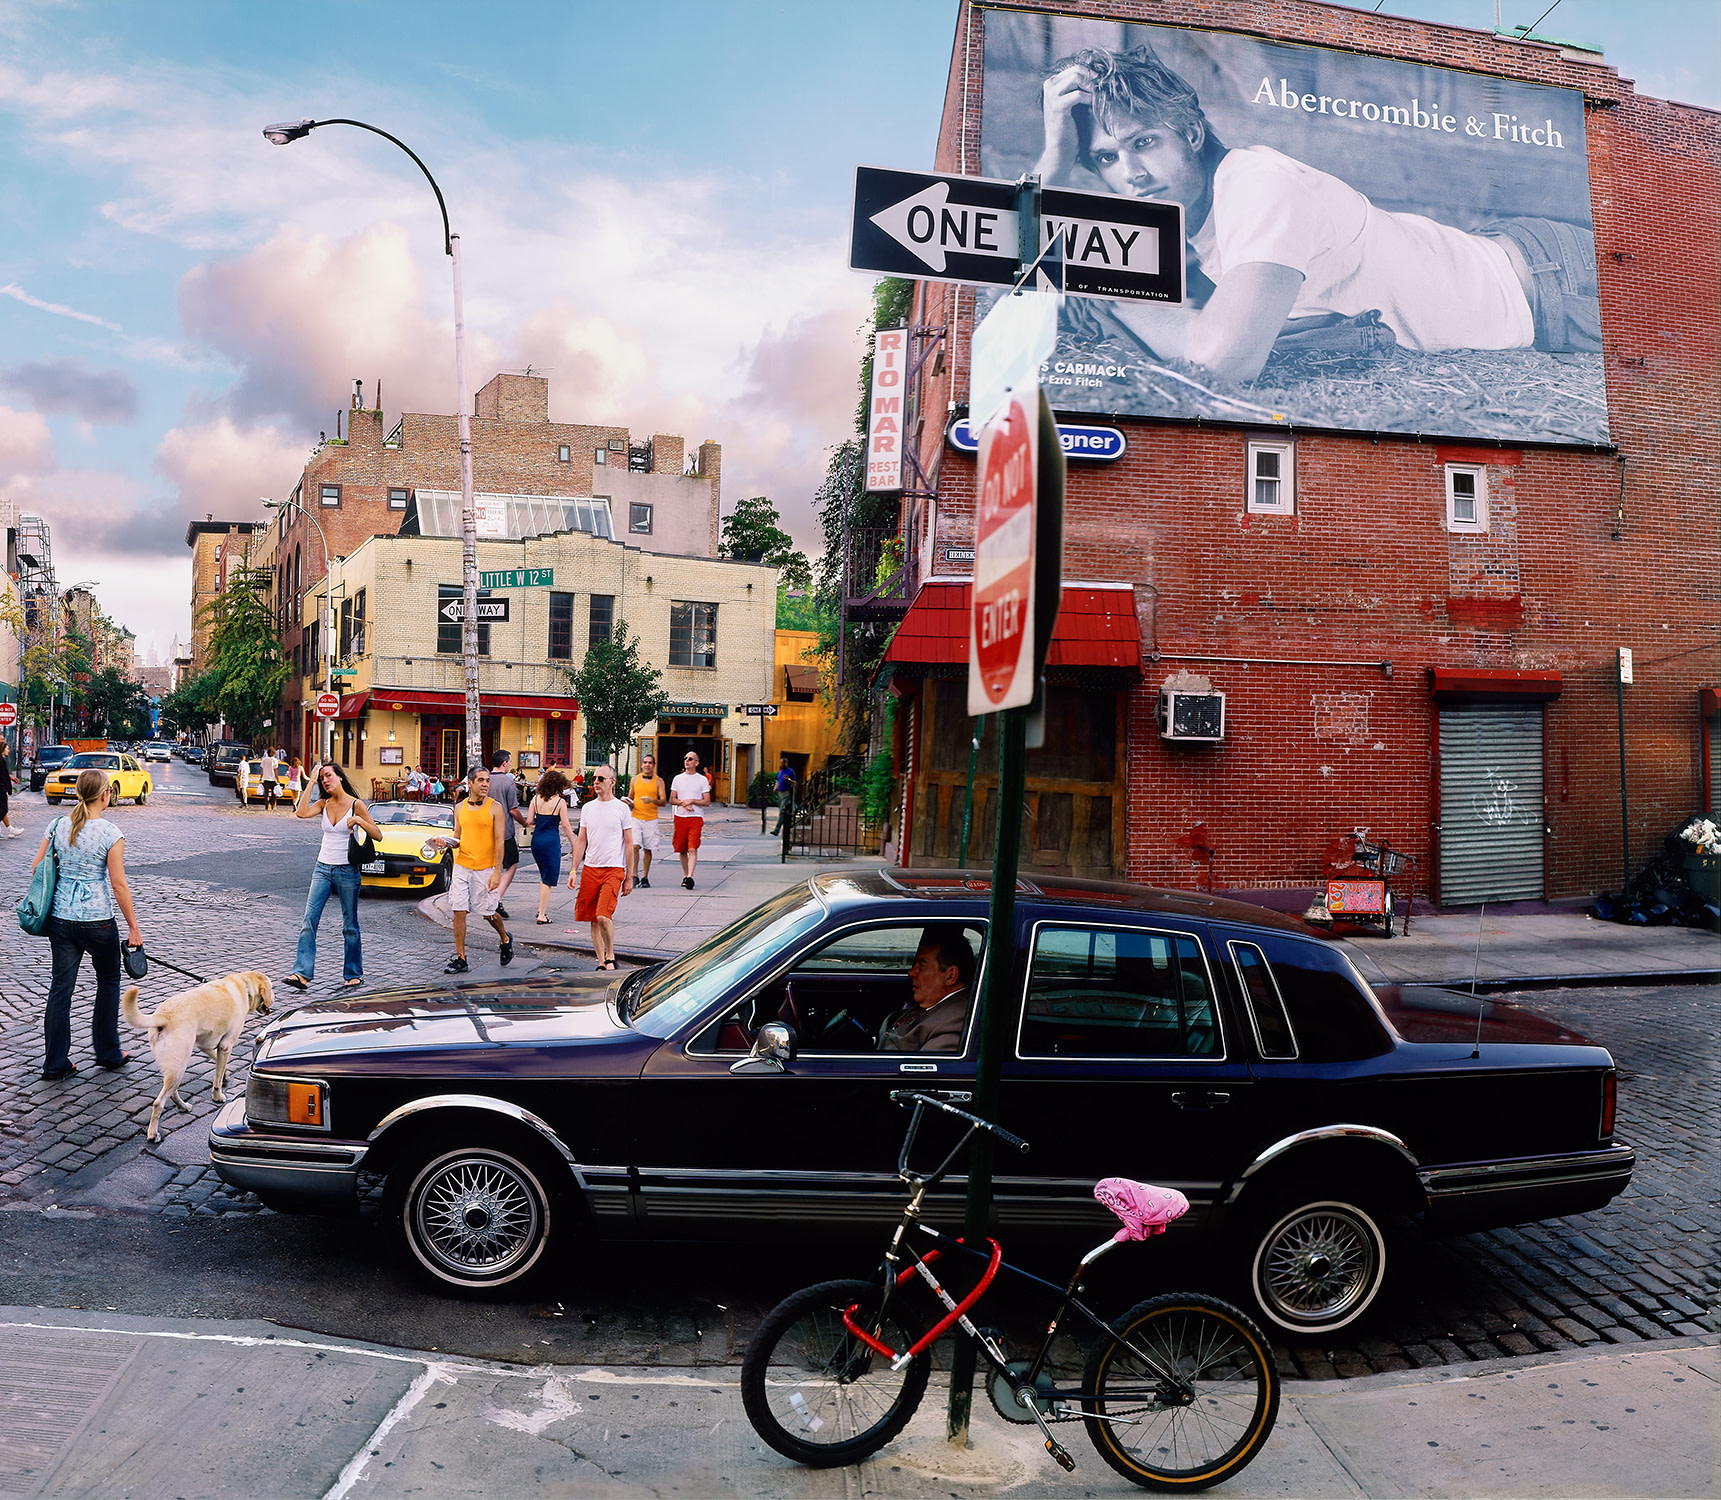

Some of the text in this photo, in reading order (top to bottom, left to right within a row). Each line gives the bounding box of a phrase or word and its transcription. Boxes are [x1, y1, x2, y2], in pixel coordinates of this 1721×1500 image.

[1251, 76, 1565, 148] Abercrombie & Fitch
[907, 205, 1140, 266] ONE WAY
[1097, 286, 1169, 299] TRANSPORTATION
[1054, 361, 1127, 378] CARMACK
[1048, 375, 1072, 385] Ezra
[1075, 376, 1103, 387] Fitch
[873, 333, 902, 453] RIO MAR
[868, 461, 899, 473] REST.
[869, 475, 896, 487] BAR
[985, 443, 1027, 522] DO NOT
[480, 569, 551, 588] LITTLE W 12 ST
[448, 605, 500, 616] ON WAY
[981, 588, 1020, 650] ENTER
[662, 705, 725, 715] MACELLERIA
